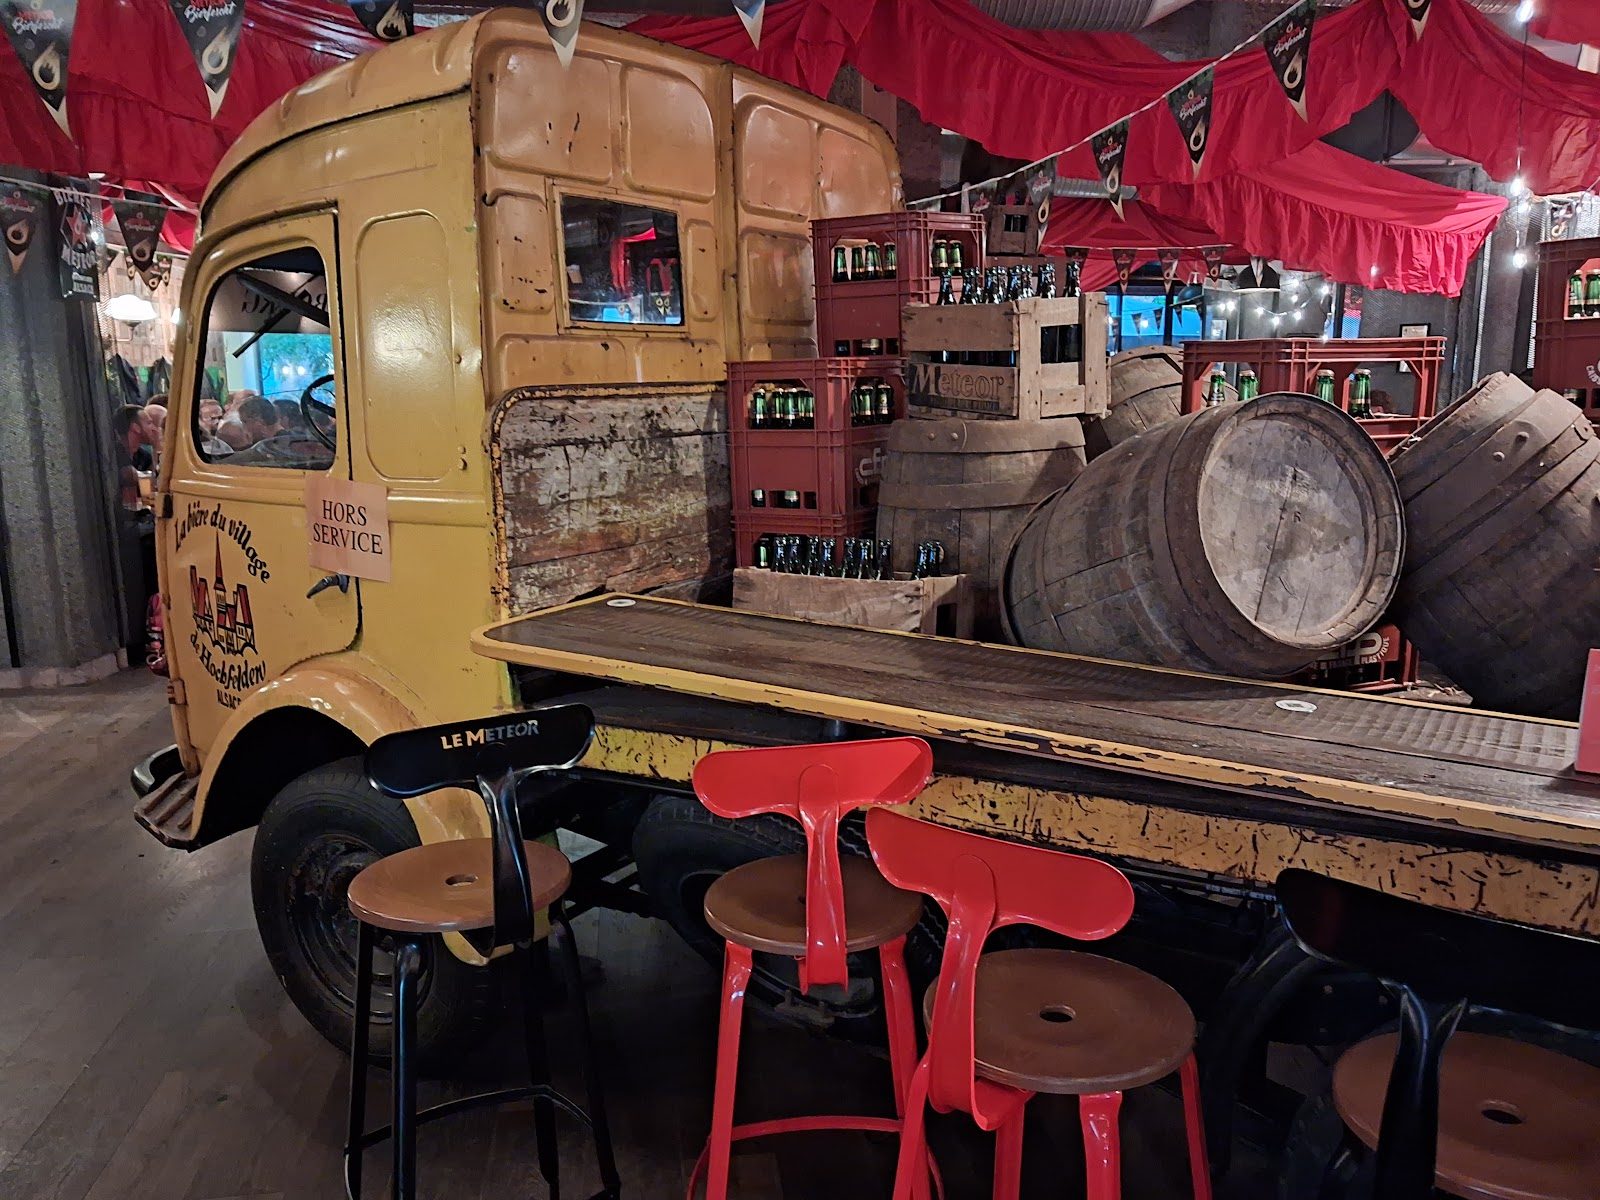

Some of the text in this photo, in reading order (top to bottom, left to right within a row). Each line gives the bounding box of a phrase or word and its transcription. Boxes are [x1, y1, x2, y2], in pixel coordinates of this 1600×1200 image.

[909, 362, 1005, 400] Meteor
[322, 499, 367, 527] HORS
[175, 518, 186, 552] La
[210, 503, 227, 532] du
[228, 519, 270, 584] village
[313, 522, 383, 555] SERVICE
[199, 642, 266, 692] Hochfelden
[1360, 636, 1391, 665] PLASTIQUE
[440, 719, 540, 750] LE METEOR
